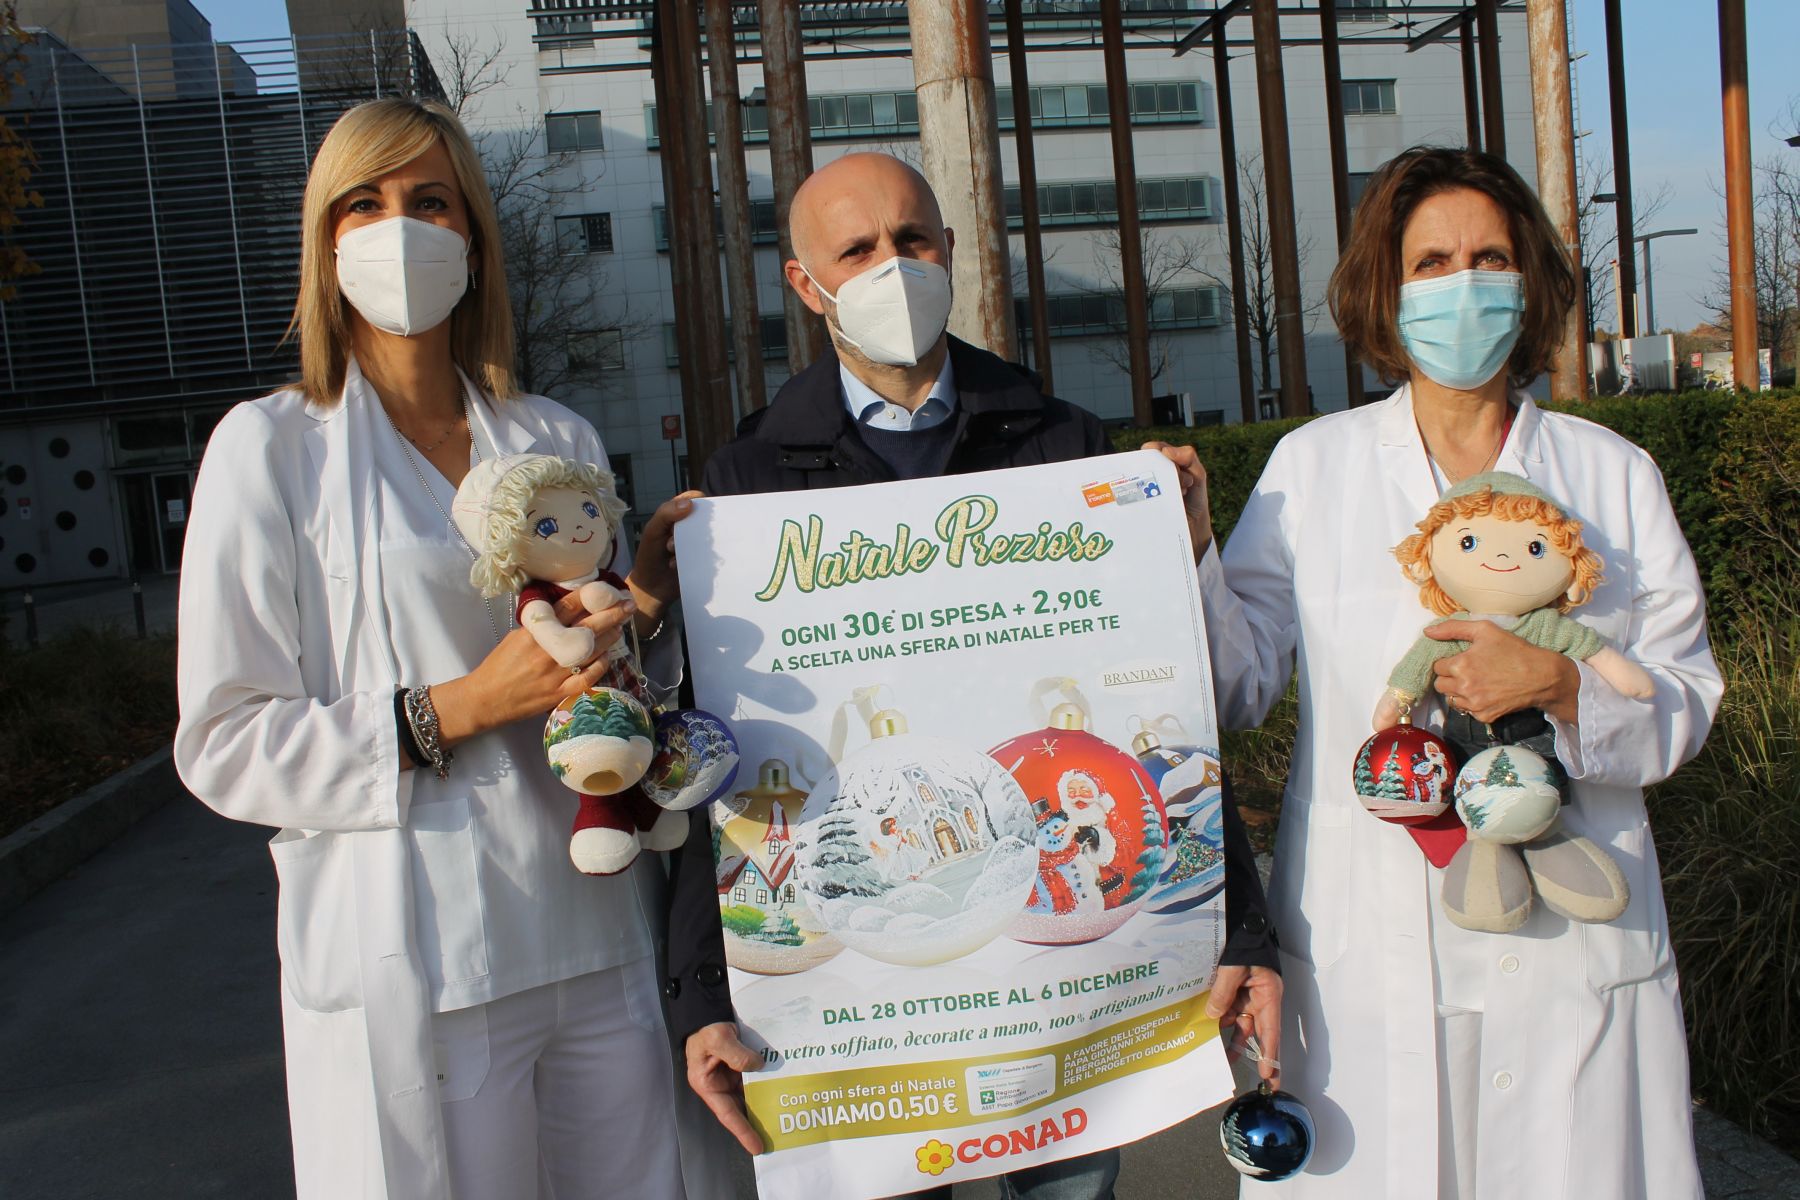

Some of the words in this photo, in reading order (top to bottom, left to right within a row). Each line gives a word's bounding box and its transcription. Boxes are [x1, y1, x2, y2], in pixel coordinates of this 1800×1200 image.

[755, 514, 939, 601] Natale
[935, 495, 1113, 568] Prezioso
[771, 658, 784, 672] A
[788, 649, 853, 670] SCELTA
[857, 644, 896, 662] UNA
[900, 636, 959, 656] SFERA
[964, 633, 981, 648] DI
[986, 623, 1054, 645] NATALE
[1059, 618, 1094, 635] PER
[1097, 615, 1120, 630] TE
[782, 623, 836, 646] OGNI
[901, 612, 924, 631] DI
[930, 602, 1007, 628] SPESA
[1012, 604, 1025, 615] +
[1032, 589, 1102, 615] 2,90€
[823, 1006, 865, 1025] DAL
[872, 1002, 896, 1020] 28
[903, 991, 1000, 1016] OTTOBRE
[1007, 987, 1034, 1005] AL
[1041, 984, 1053, 999] 6
[1059, 961, 1159, 998] DICEMBRE
[784, 1044, 825, 1060] vetro
[830, 1035, 898, 1058] soffiato,
[904, 1027, 974, 1047] decorate
[979, 1028, 988, 1040] a
[993, 1020, 1042, 1037] mano,
[1049, 1012, 1085, 1030] 100%
[1089, 984, 1165, 1021] artigianali
[1064, 1056, 1089, 1070] PAPA
[1091, 1038, 1133, 1061] GIOVANNI
[1136, 1030, 1155, 1042] XXIII
[1073, 1038, 1109, 1058] FAVORE
[1110, 1011, 1181, 1044] DELL'OSPEDALE
[1063, 1074, 1082, 1087] PER
[1084, 1070, 1093, 1079] IL
[1095, 1051, 1143, 1075] PROGETTO
[1144, 1030, 1195, 1056] GIOCAMICO
[1064, 1069, 1074, 1078] DI
[1075, 1051, 1120, 1075] BERGAMO
[779, 1094, 808, 1107] Con
[812, 1087, 843, 1103] ogni
[848, 1084, 886, 1098] sfera
[890, 1080, 904, 1094] di
[907, 1076, 956, 1092] Natale
[779, 1101, 885, 1134] DONIAMO
[957, 1107, 1088, 1163] CONAD
